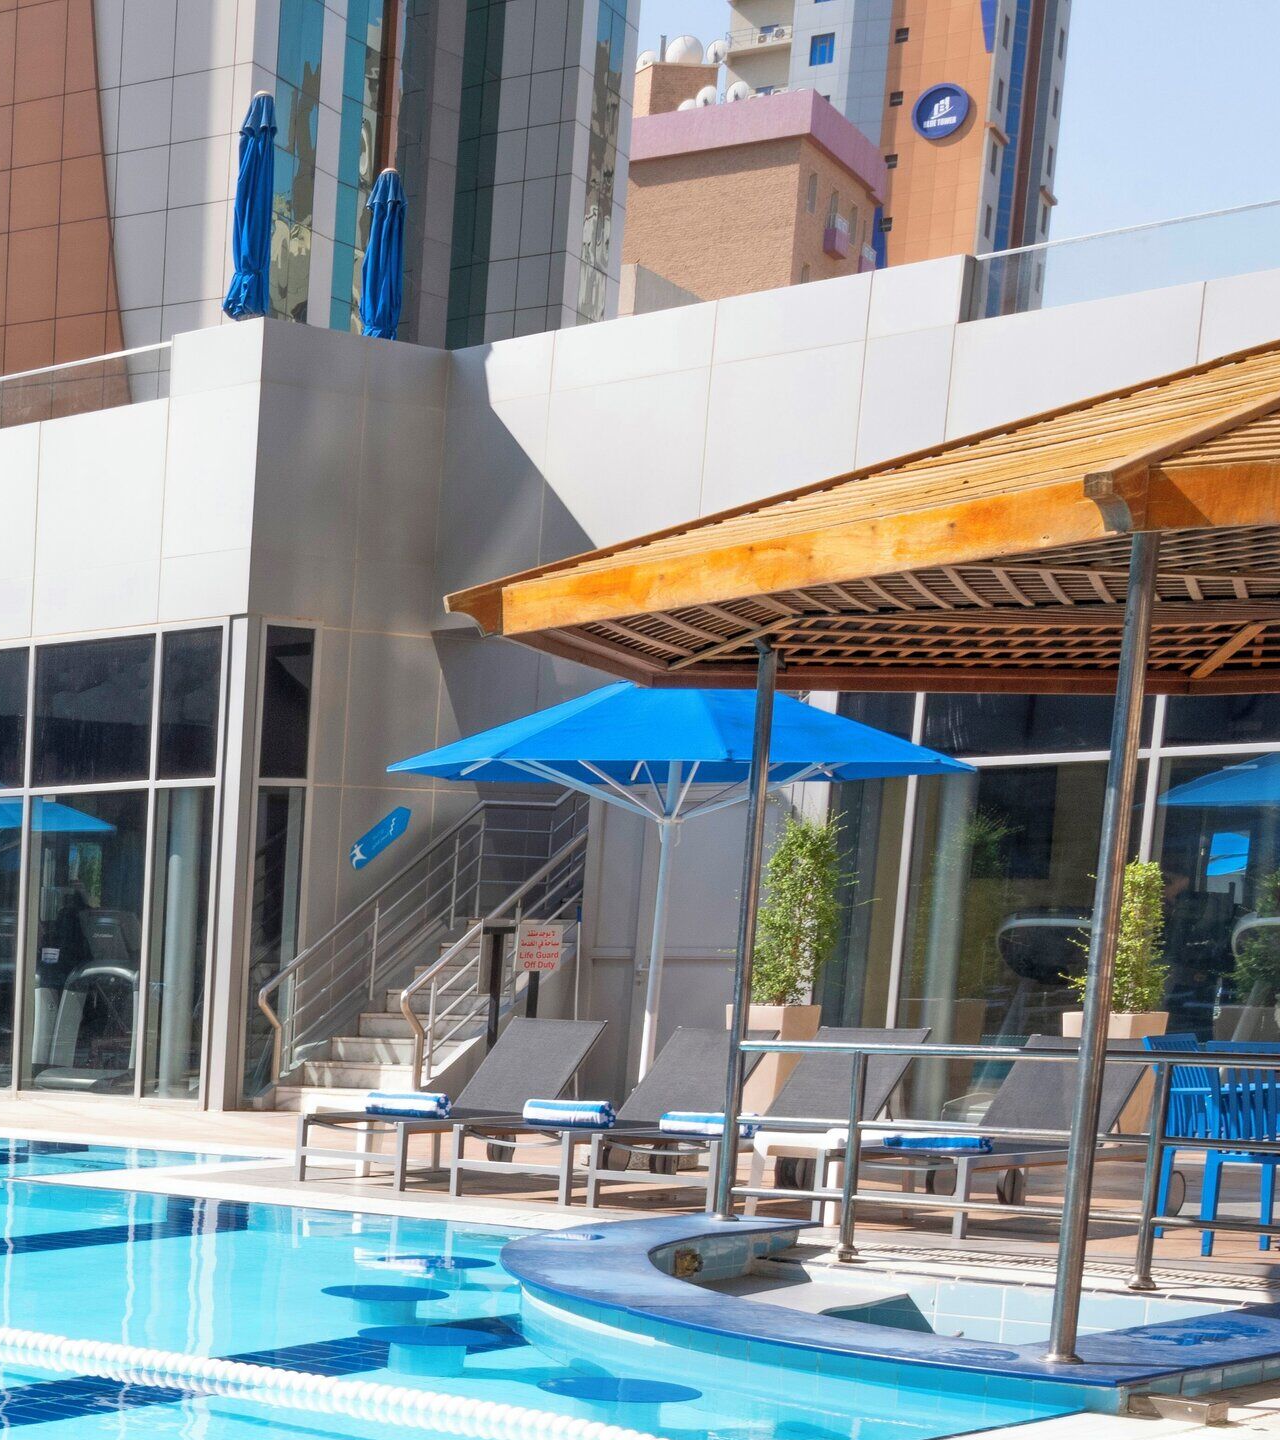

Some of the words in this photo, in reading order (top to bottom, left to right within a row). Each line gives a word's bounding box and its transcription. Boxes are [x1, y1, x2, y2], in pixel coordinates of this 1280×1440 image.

[519, 951, 534, 959] Life
[536, 951, 559, 959] Guard
[523, 960, 536, 969] Off
[537, 960, 555, 969] Duty
